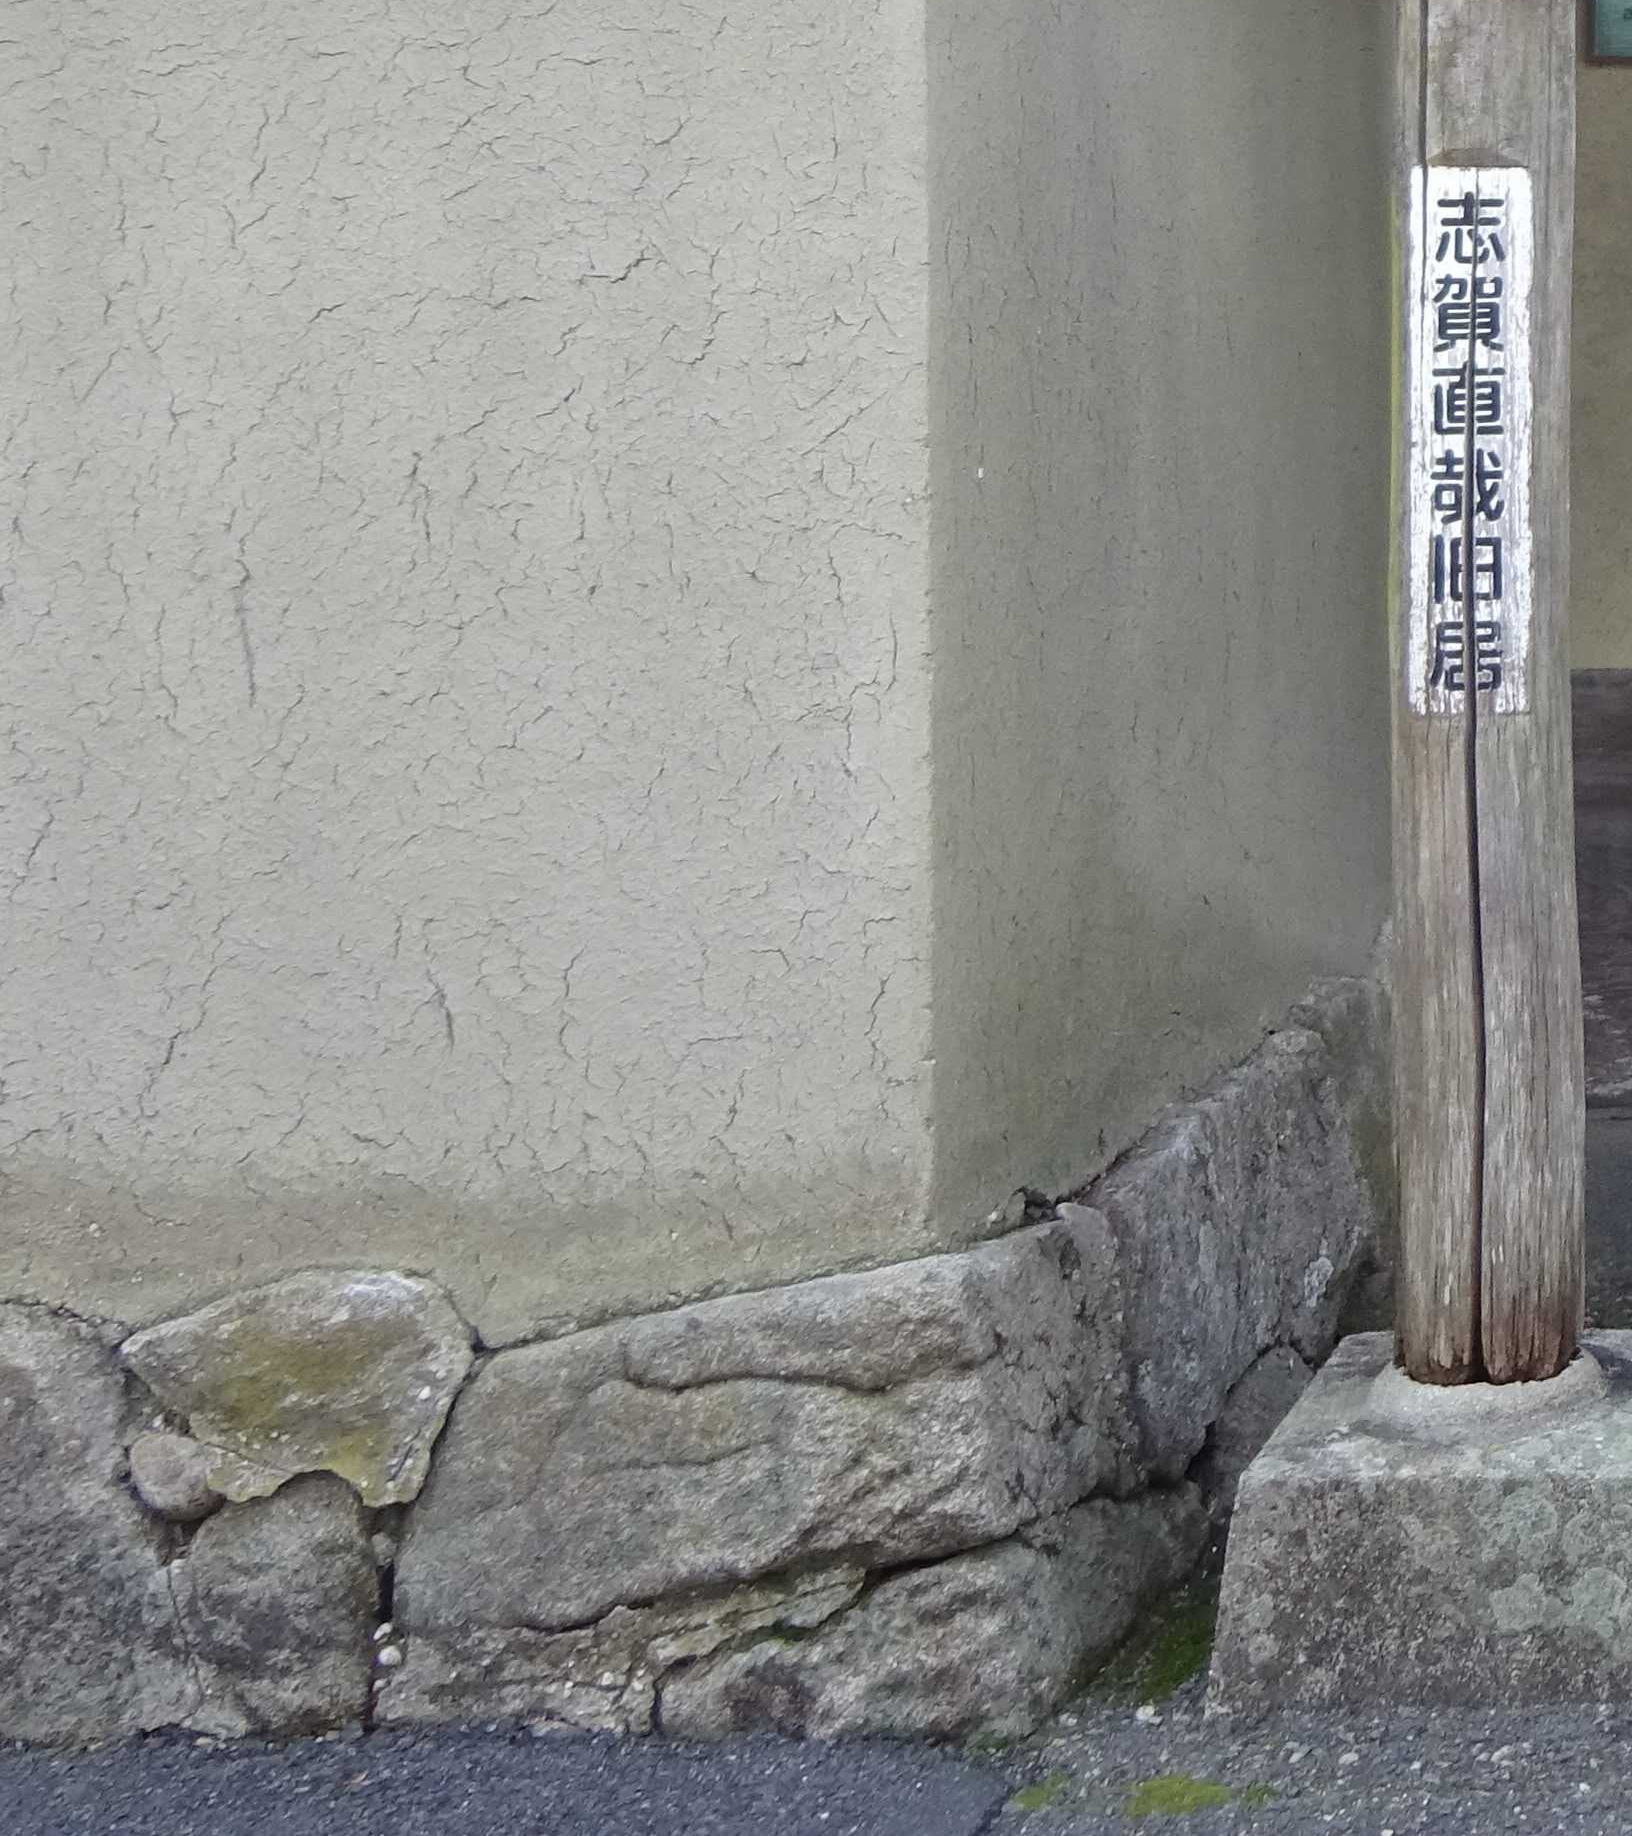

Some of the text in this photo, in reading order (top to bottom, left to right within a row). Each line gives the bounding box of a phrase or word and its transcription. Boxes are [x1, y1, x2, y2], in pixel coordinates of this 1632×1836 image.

[1430, 191, 1506, 691] 志賀直哉旧居
